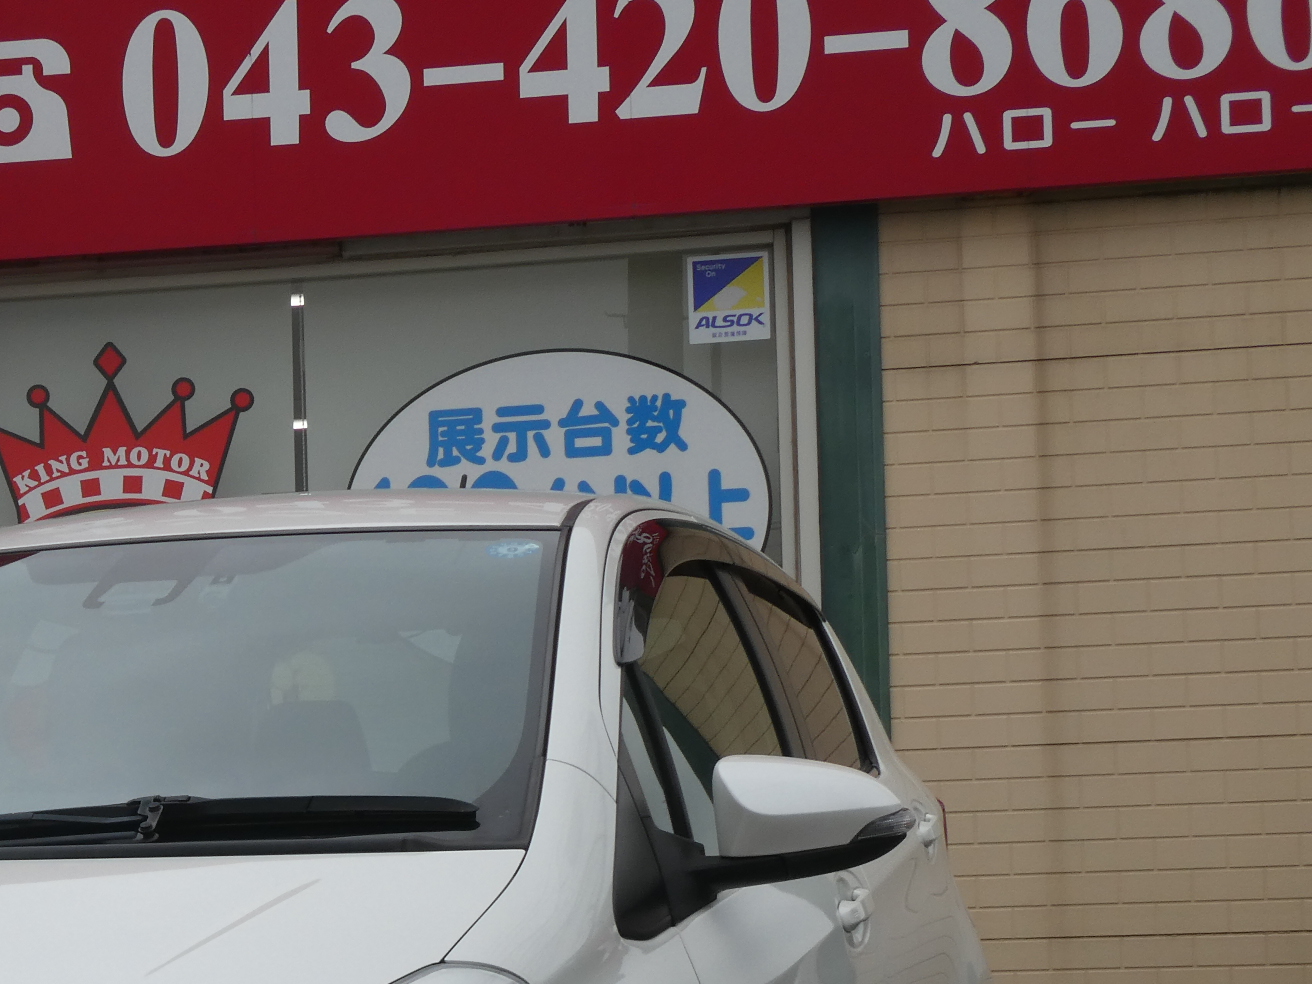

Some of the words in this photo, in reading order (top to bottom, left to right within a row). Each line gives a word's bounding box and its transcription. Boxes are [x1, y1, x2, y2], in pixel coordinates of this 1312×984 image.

[931, 107, 1117, 158] ハロー
[696, 263, 726, 271] Security
[705, 270, 716, 278] On
[694, 312, 765, 330] ALSOK
[426, 392, 688, 468] 展示台数
[13, 451, 89, 495] KING
[102, 446, 211, 481] MOTOR
